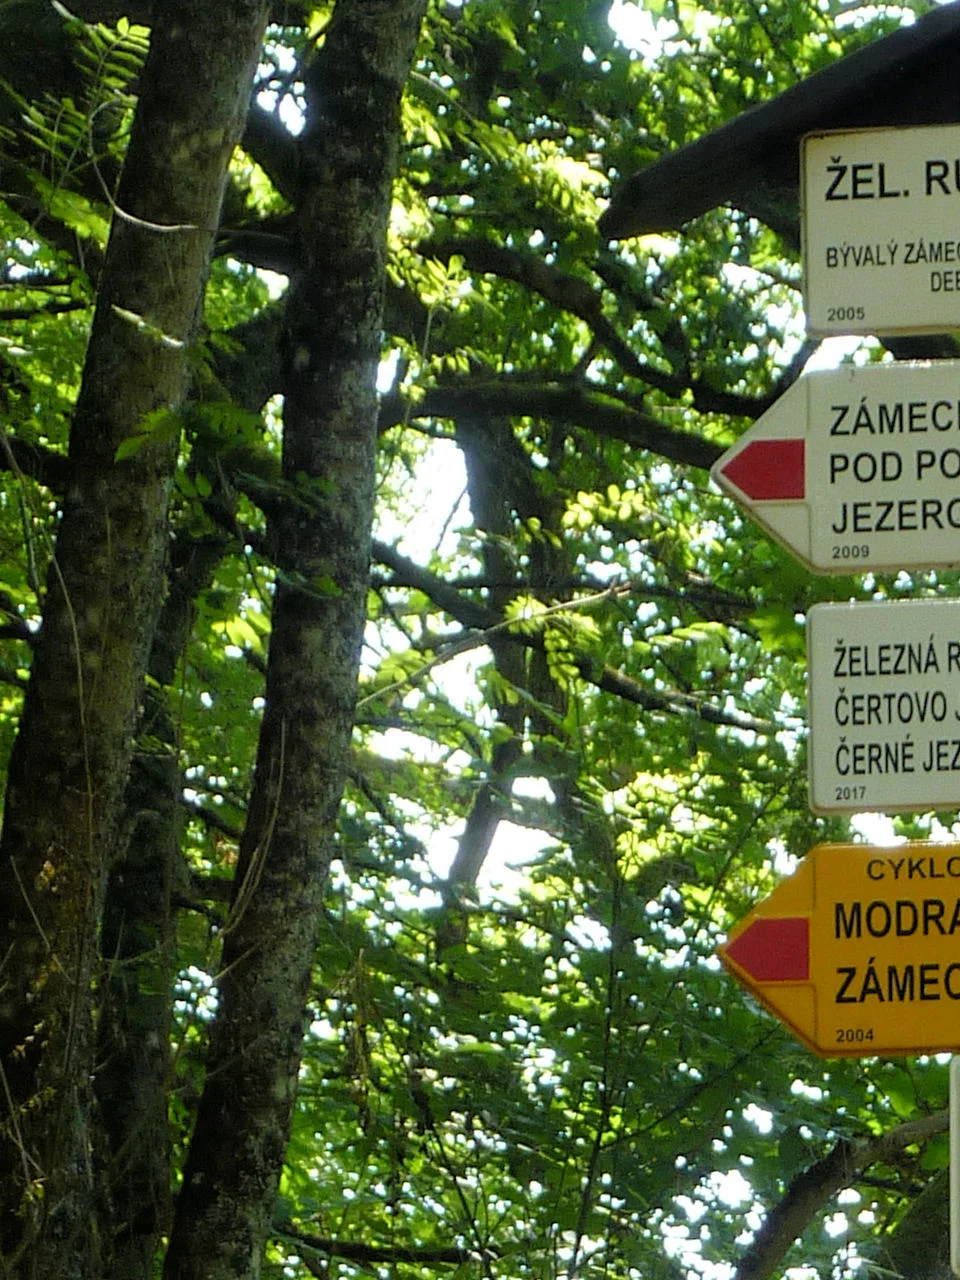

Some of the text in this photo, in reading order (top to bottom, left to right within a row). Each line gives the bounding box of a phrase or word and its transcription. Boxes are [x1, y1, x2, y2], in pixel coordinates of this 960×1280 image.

[825, 156, 909, 201] ŽEL.
[826, 237, 898, 268] BÝVALÝ
[827, 307, 865, 321] 2005
[829, 450, 902, 485] POD
[831, 545, 870, 559] 2009
[833, 634, 940, 678] ŽELEZNÁ
[835, 685, 947, 726] ČERTOVO
[836, 733, 915, 776] ČERNÉ
[835, 786, 866, 800] 2017
[836, 1028, 874, 1043] 2004
